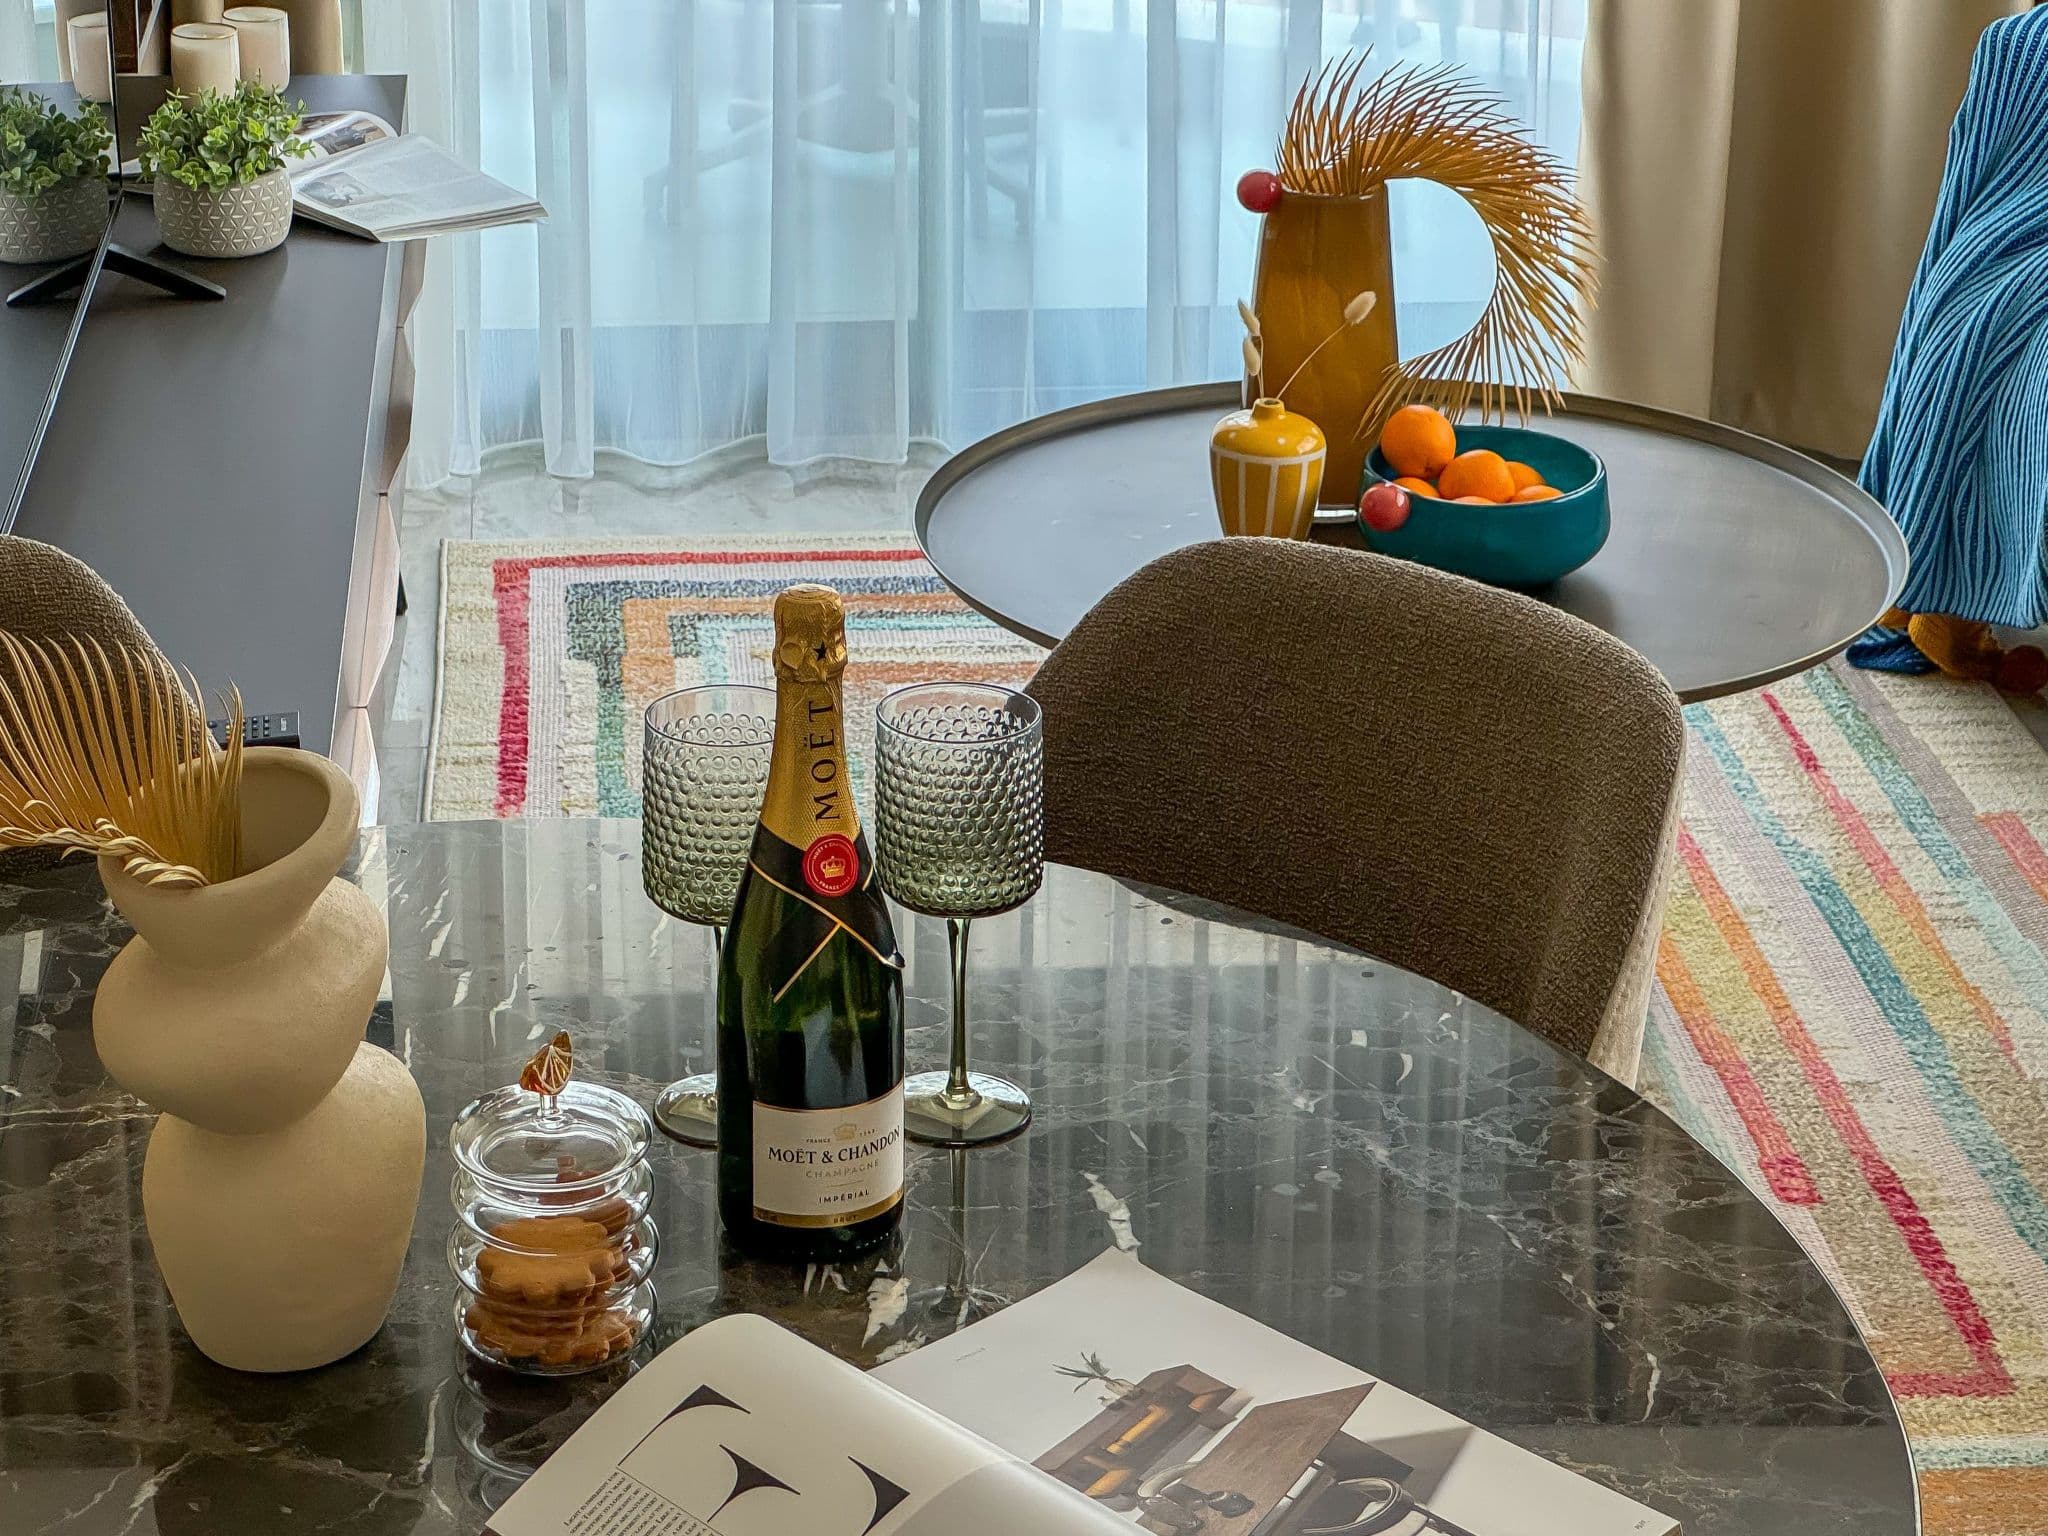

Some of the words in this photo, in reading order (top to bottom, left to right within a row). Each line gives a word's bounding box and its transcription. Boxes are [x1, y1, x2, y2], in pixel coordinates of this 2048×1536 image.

[804, 700, 840, 823] MOËT
[768, 1147, 816, 1164] MOËT
[821, 1150, 834, 1163] &
[838, 1124, 900, 1160] CHANDON
[805, 1159, 879, 1179] CHAMPAGNE
[819, 1189, 870, 1204] IMPÉRIAL
[833, 1215, 857, 1224] BRUT
